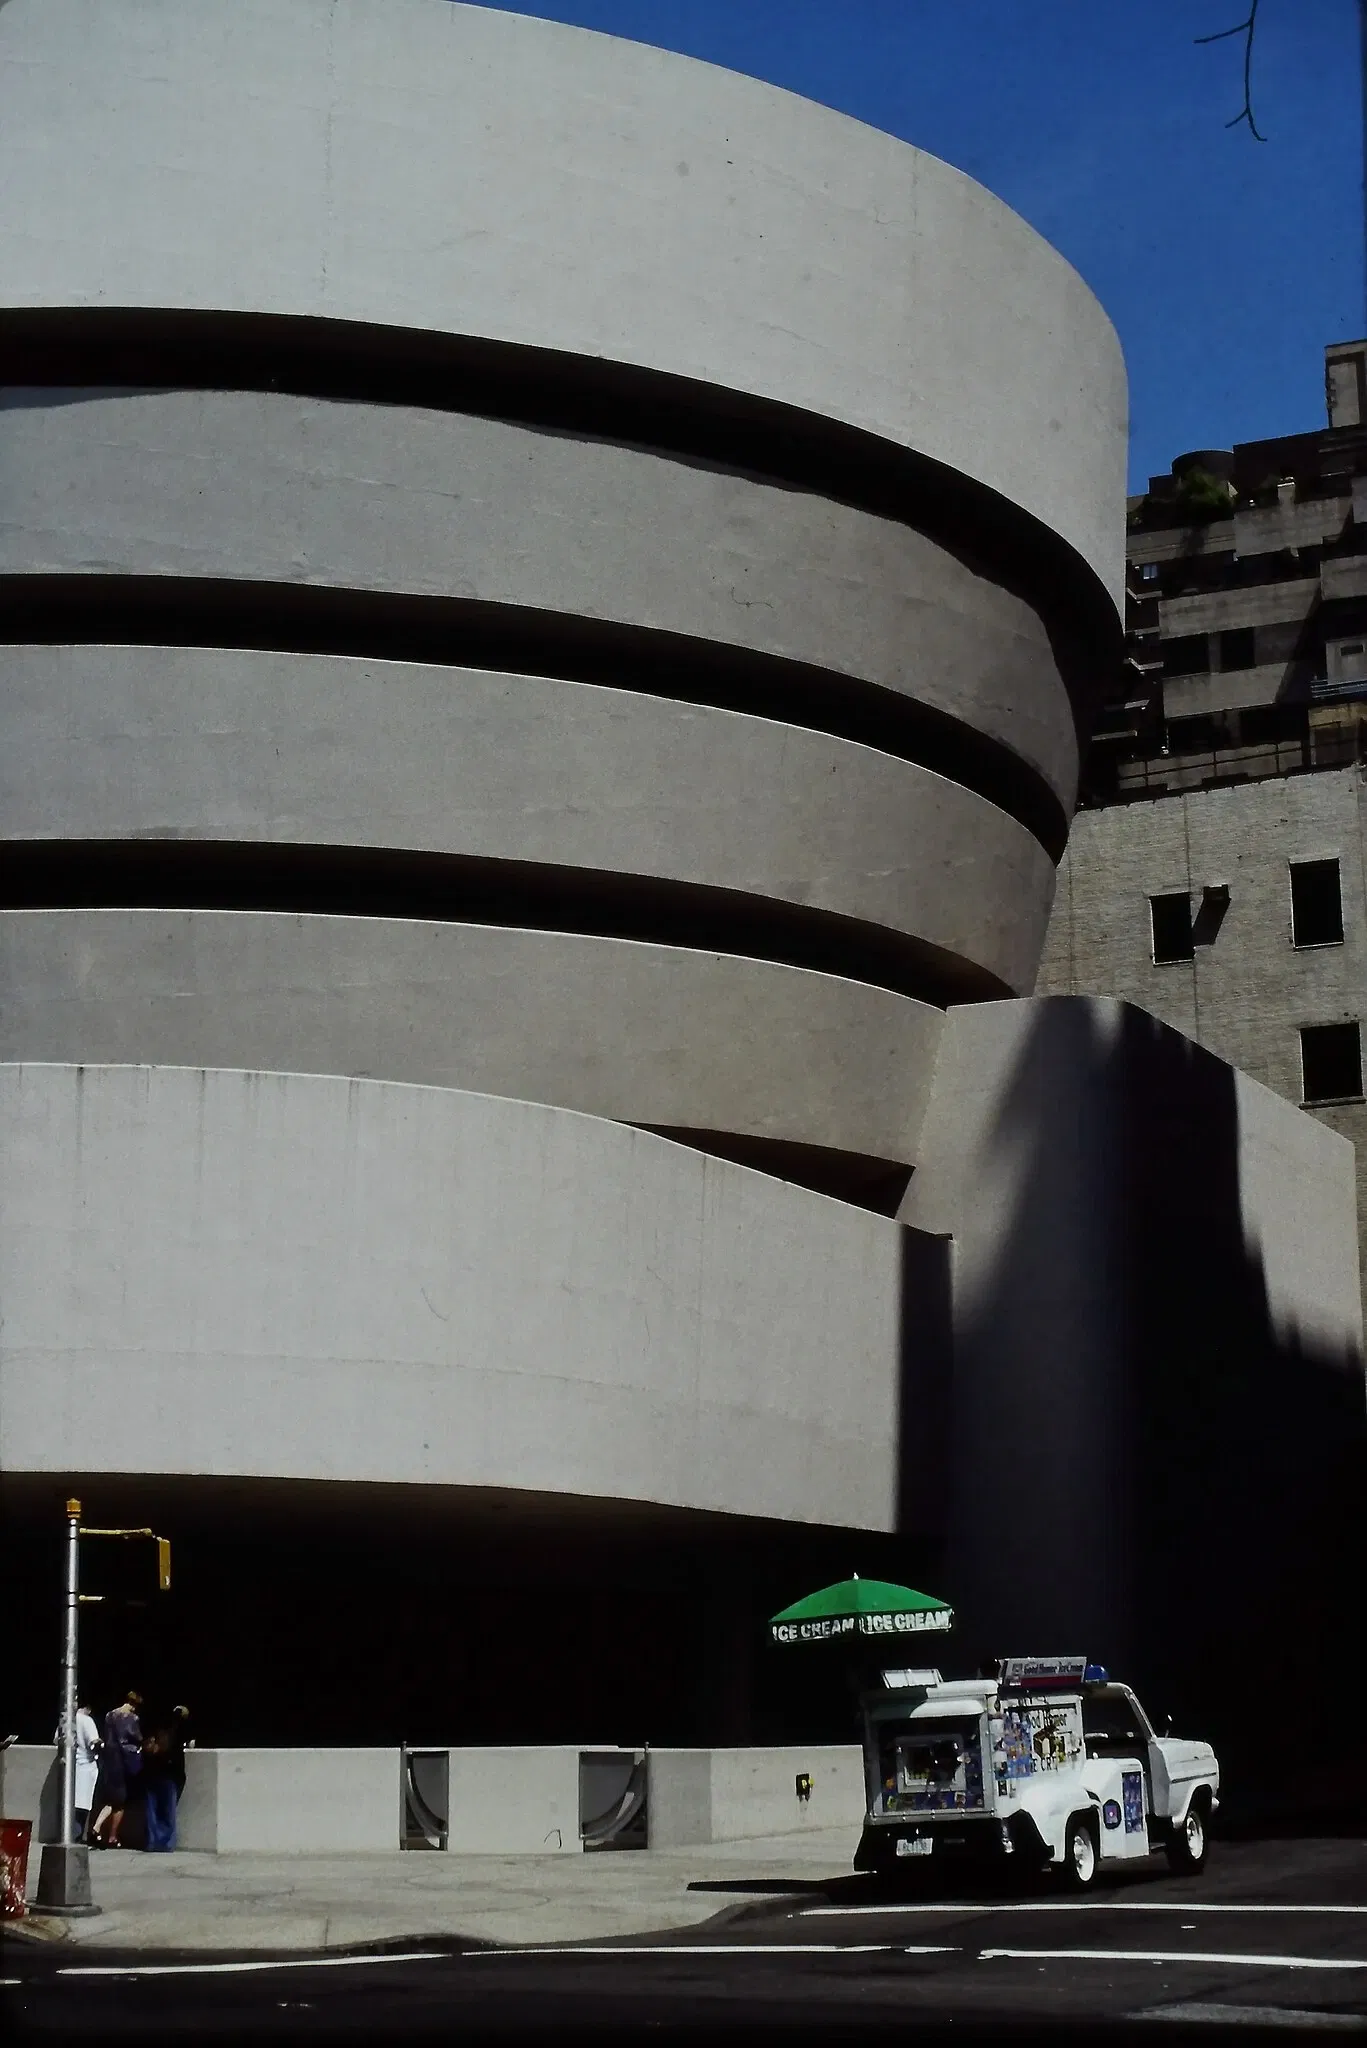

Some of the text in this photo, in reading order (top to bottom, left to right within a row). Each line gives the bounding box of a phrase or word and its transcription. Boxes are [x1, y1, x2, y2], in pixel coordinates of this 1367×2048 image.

[772, 1617, 855, 1641] ICE CREAM
[866, 1610, 951, 1631] ICE CREAM
